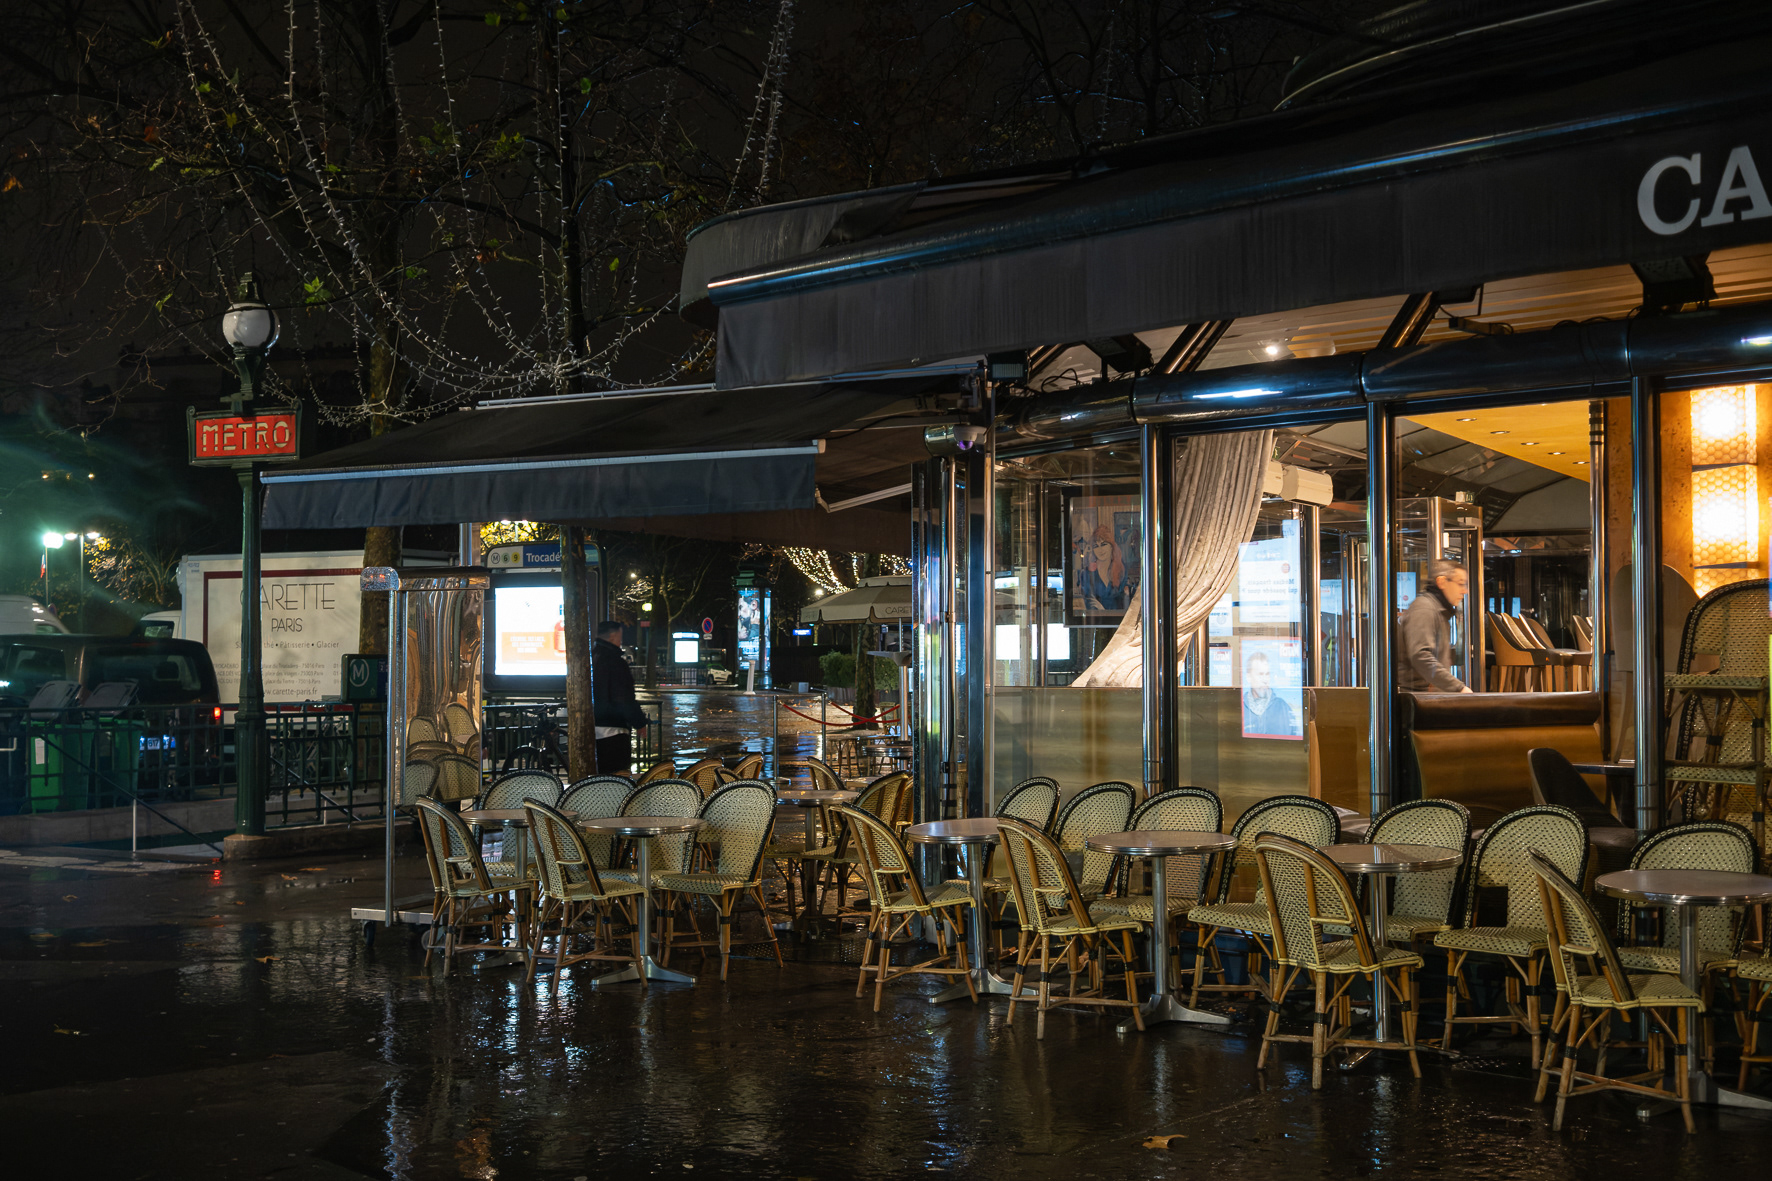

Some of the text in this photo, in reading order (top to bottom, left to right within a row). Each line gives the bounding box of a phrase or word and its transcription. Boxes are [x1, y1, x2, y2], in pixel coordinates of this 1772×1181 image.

[1637, 145, 1772, 236] CA
[202, 421, 290, 452] METRO
[526, 552, 560, 562] Trocadé
[240, 583, 335, 610] ARETTE
[885, 606, 912, 615] CARET
[271, 617, 303, 632] PARIS
[264, 641, 274, 649] thé
[317, 641, 339, 649] Glacier
